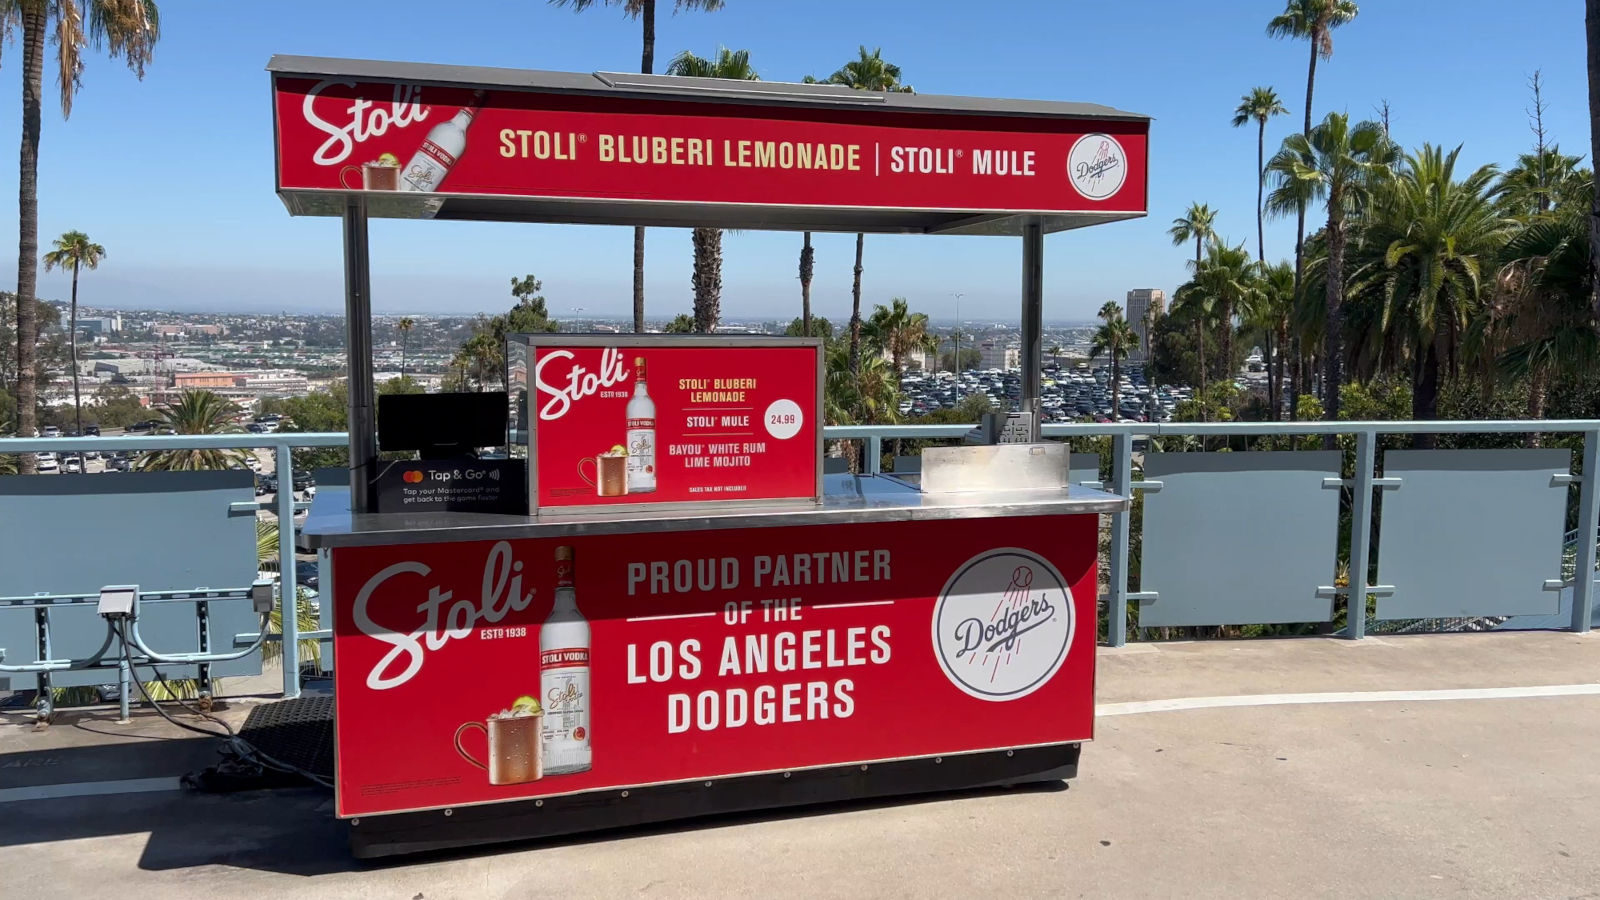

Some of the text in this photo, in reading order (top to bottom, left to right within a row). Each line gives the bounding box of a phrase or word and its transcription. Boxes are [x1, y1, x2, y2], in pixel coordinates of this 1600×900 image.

[599, 134, 713, 166] BLUBERI
[724, 139, 861, 171] LEMONADE
[972, 149, 1036, 176] MULE
[1076, 153, 1119, 180] Dodgers
[714, 378, 757, 390] BLUBERI
[690, 391, 746, 403] LEMONADE
[721, 415, 750, 427] MULE
[771, 414, 795, 425] 24.99
[708, 443, 740, 454] WHITE
[743, 442, 766, 453] RUM
[684, 455, 751, 468] LIME MOJITO
[428, 469, 451, 483] Tap
[453, 469, 463, 480] &
[418, 488, 436, 496] your
[403, 496, 416, 504] get
[417, 495, 434, 503] back
[627, 549, 892, 597] PROUD PARTNER
[724, 597, 803, 626] OF THE
[954, 592, 1055, 659] Dodgers
[505, 627, 527, 638] 1938
[541, 652, 589, 664] STOLI VODKA
[626, 625, 892, 685] LOS ANGELES
[667, 678, 855, 734] DODGERS
